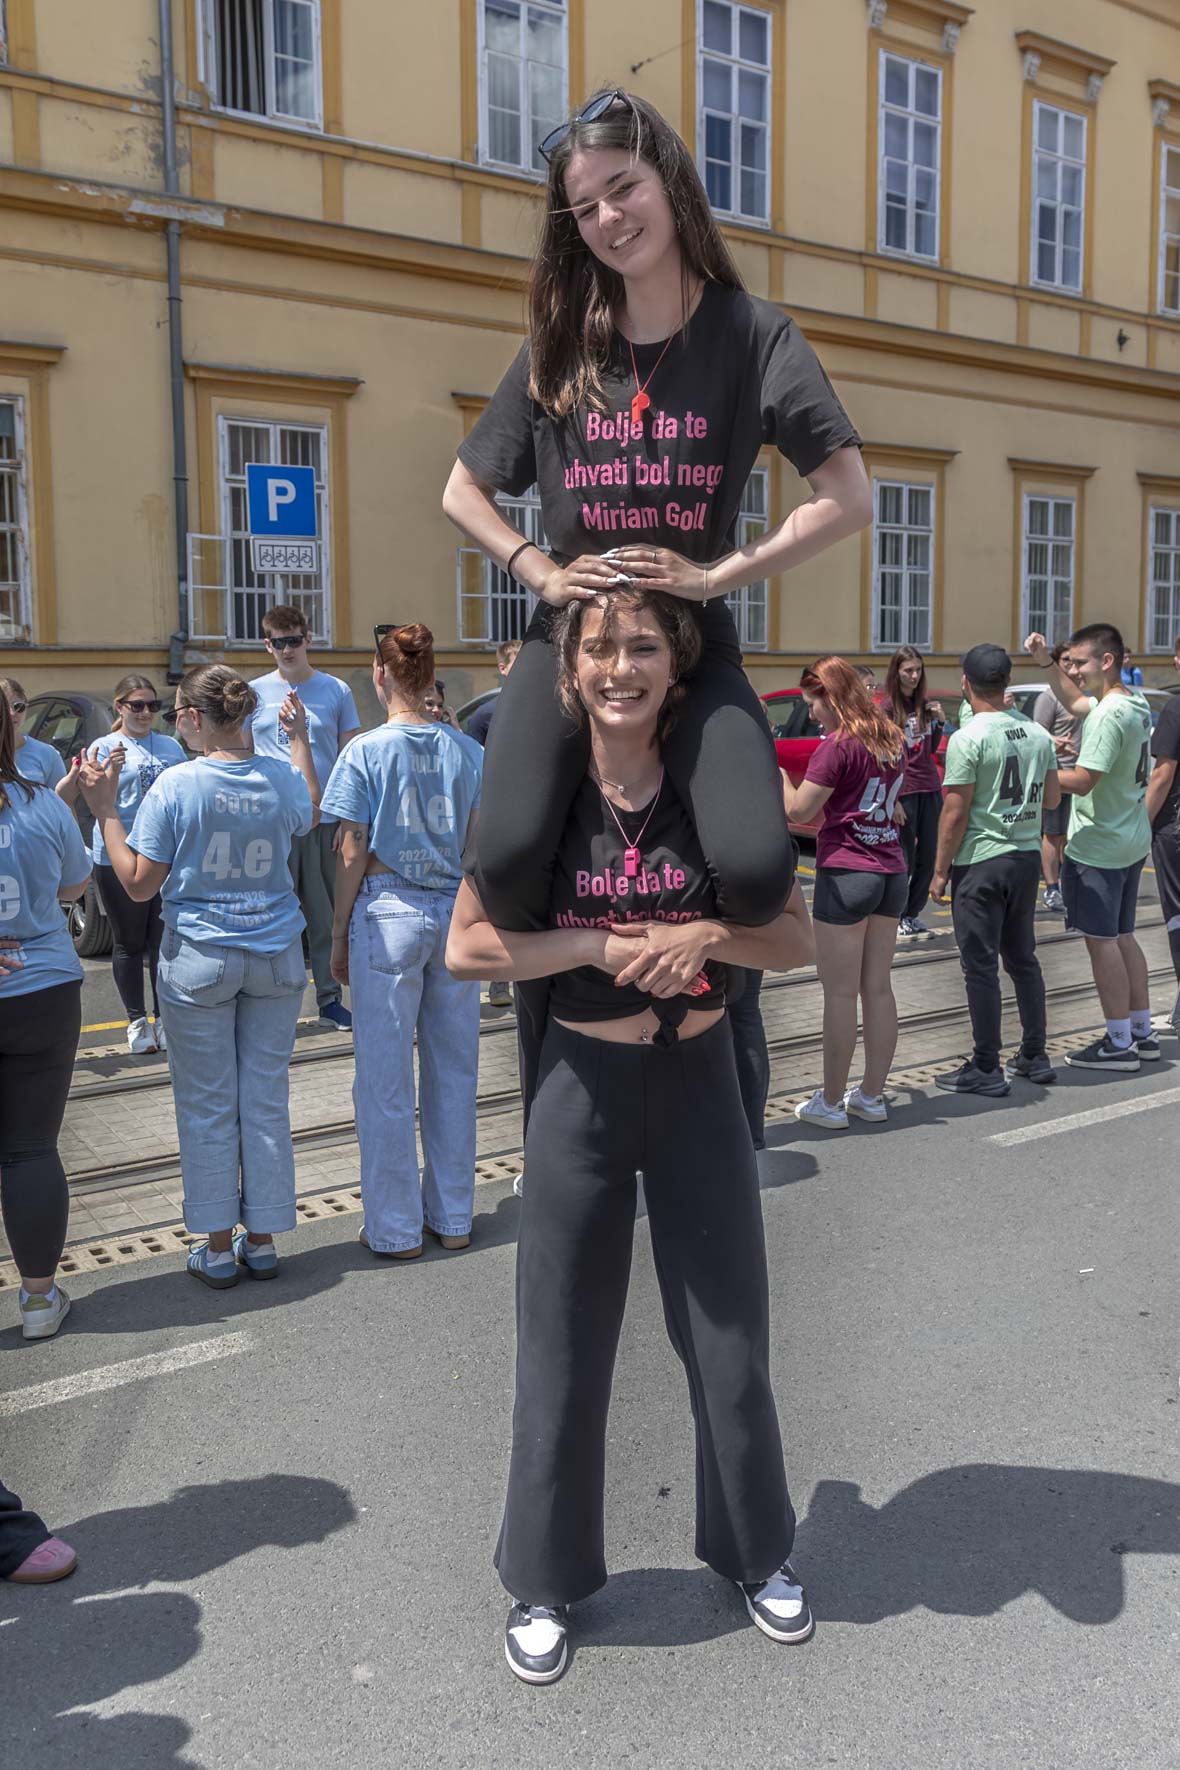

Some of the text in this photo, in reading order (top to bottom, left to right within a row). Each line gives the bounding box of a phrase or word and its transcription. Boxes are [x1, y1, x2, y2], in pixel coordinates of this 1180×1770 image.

[587, 411, 708, 447] Bolje da te
[565, 456, 724, 494] uhvati bol nego
[267, 478, 297, 522] P
[582, 502, 707, 531] Miriam Goll
[1000, 755, 1023, 806] 4
[202, 831, 273, 881] 4.e
[636, 866, 661, 894] da
[663, 863, 686, 890] te
